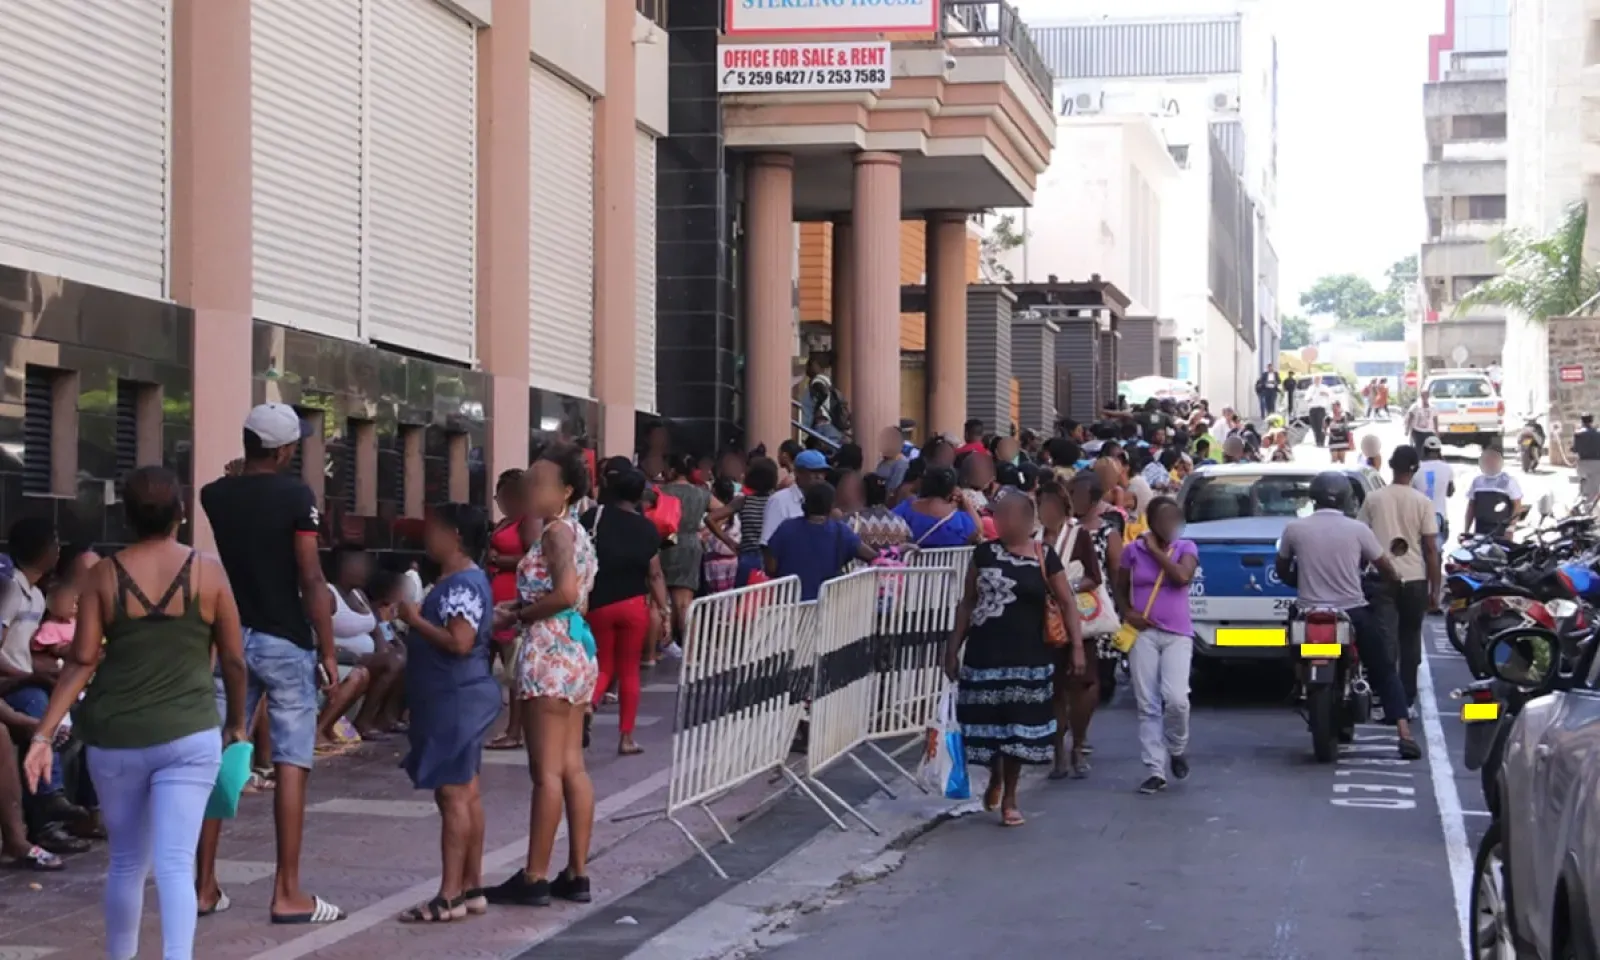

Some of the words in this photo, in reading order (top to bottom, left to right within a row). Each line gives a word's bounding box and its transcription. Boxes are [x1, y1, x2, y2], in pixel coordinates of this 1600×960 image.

[724, 49, 770, 68] OFFICE
[773, 48, 799, 67] FOR
[802, 47, 834, 67] SALE
[838, 50, 847, 66] &
[851, 47, 886, 65] RENT
[737, 71, 746, 85] 5
[748, 71, 773, 85] 259
[775, 70, 806, 85] 6427
[816, 69, 825, 84] 5
[827, 69, 852, 84] 253
[854, 68, 886, 83] 7583
